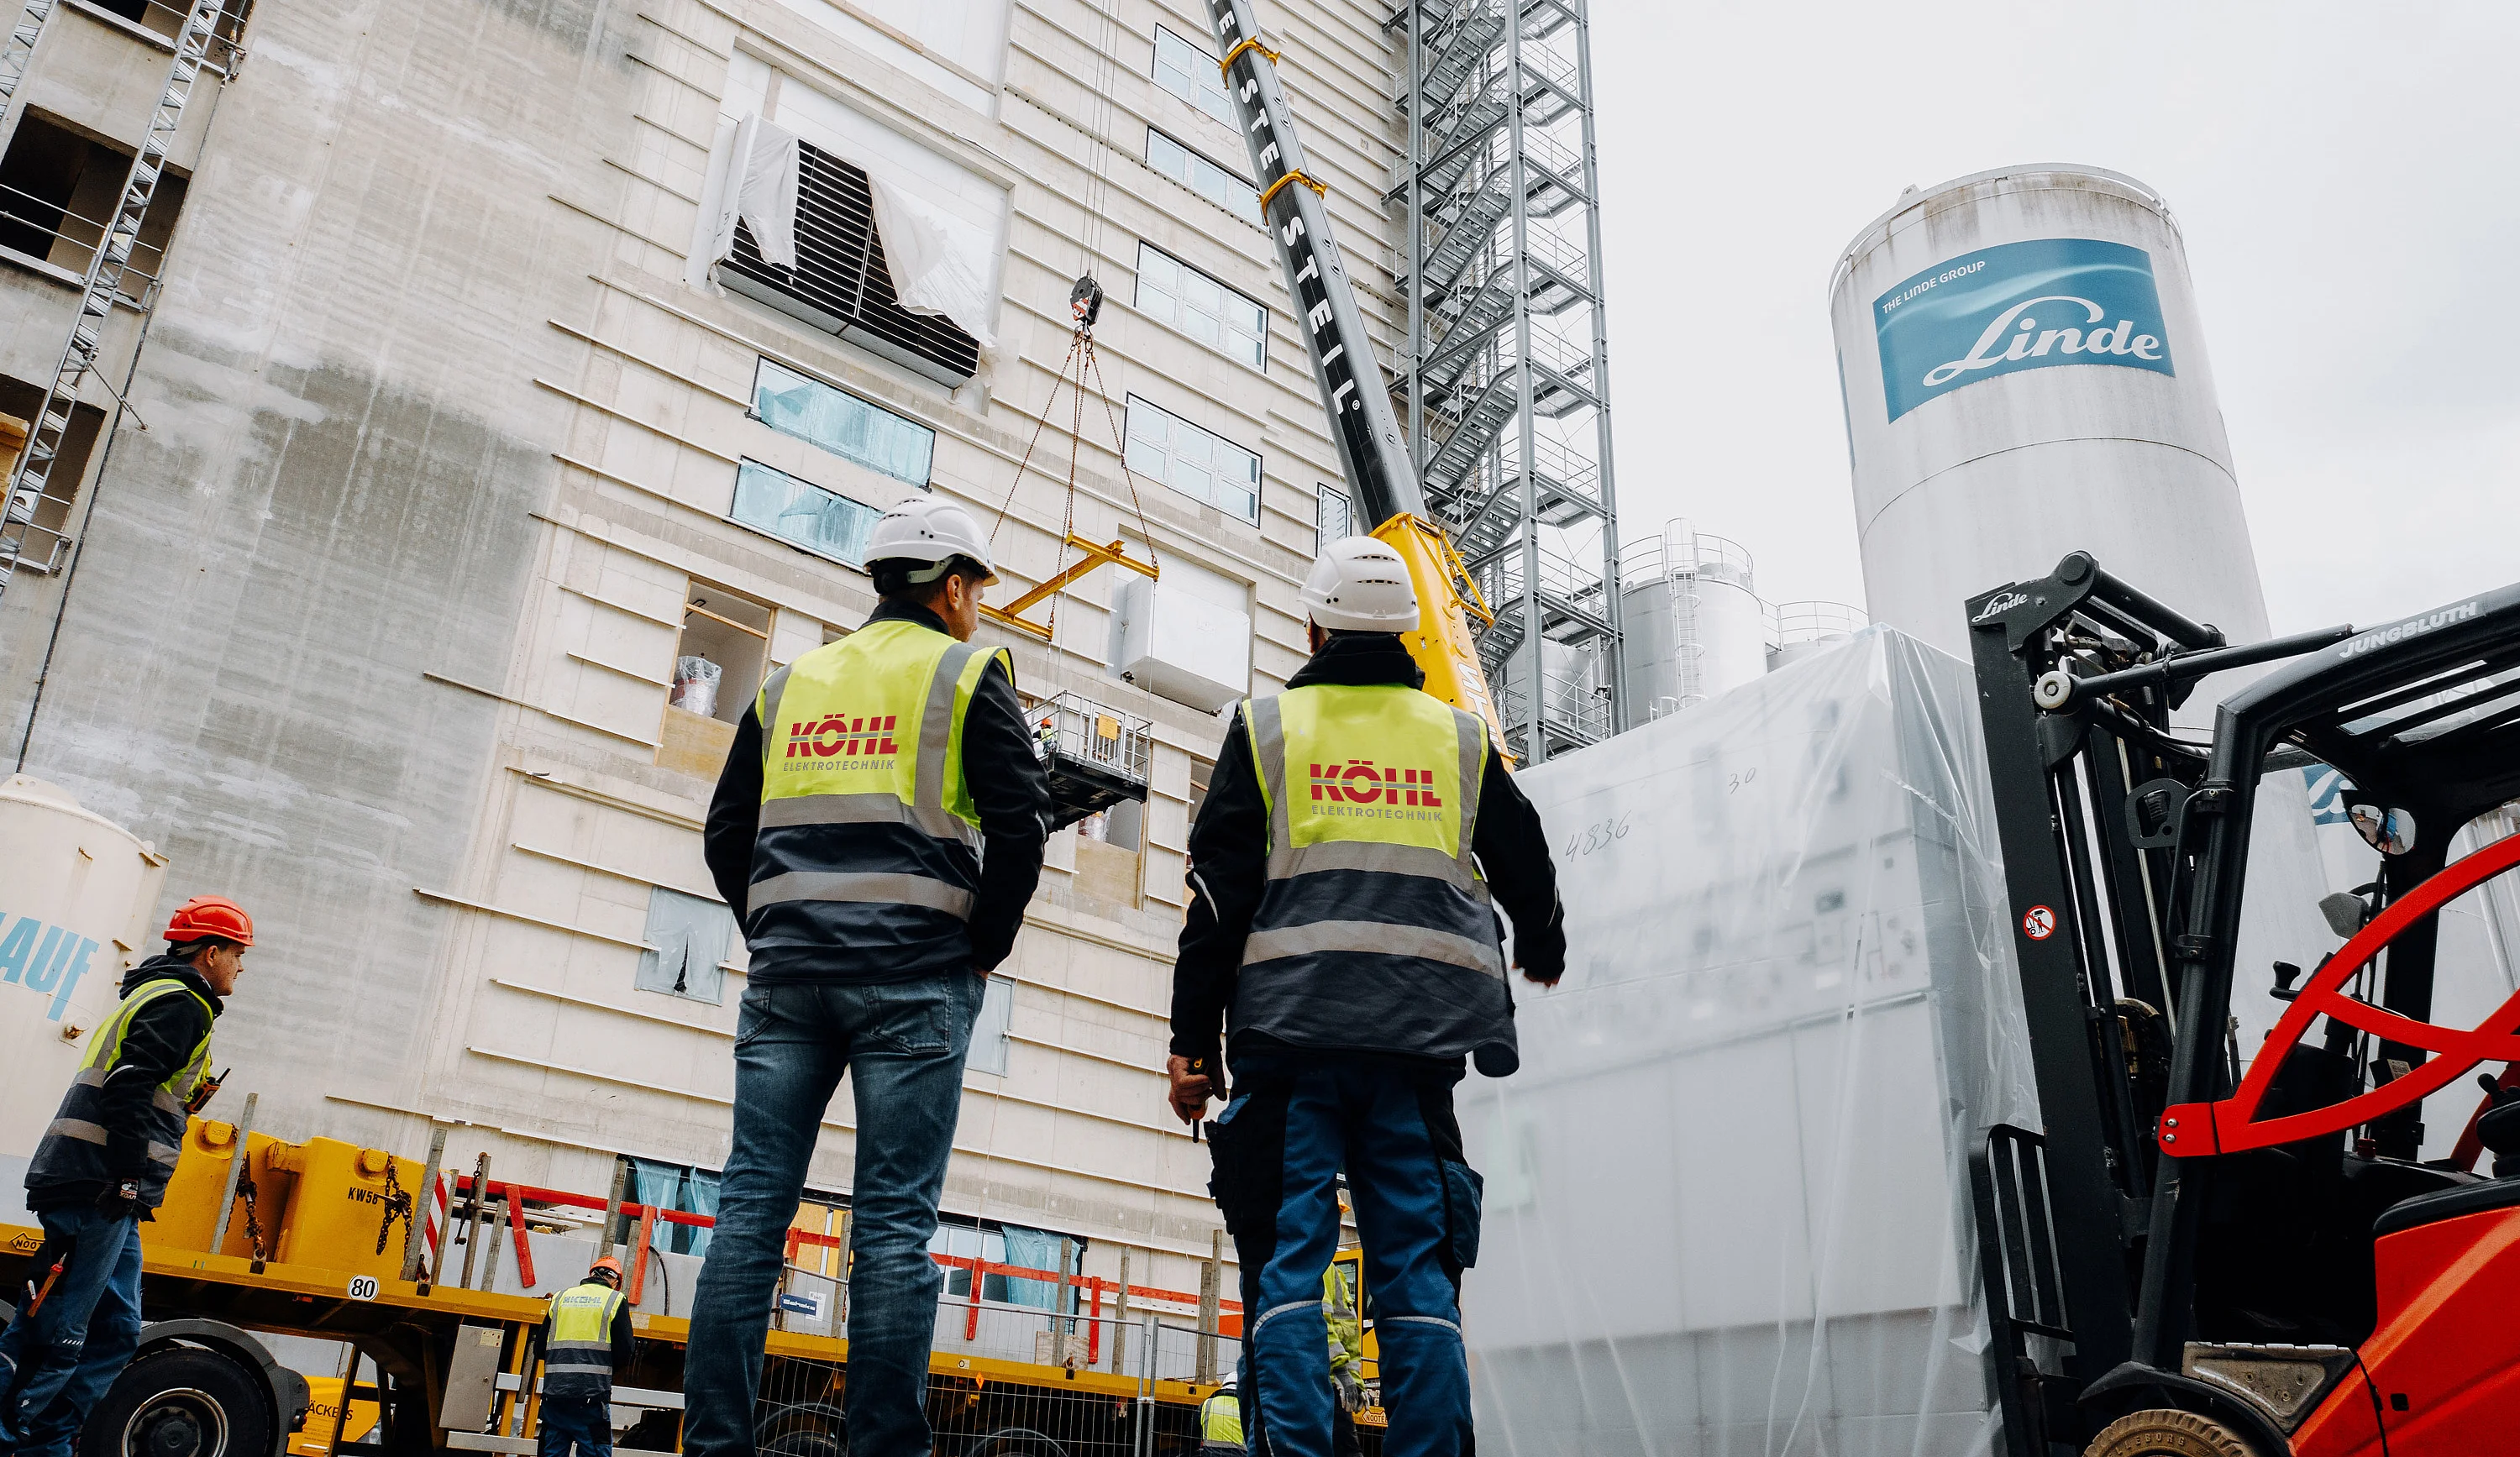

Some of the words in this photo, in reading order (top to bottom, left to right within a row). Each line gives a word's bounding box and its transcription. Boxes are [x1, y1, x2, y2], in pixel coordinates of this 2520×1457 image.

[1882, 296, 1902, 314] THE
[1904, 277, 1937, 301] LINDE
[1939, 260, 1986, 283] GROUP
[1923, 296, 2162, 386] Linde
[1971, 593, 2028, 622] Linde
[2339, 602, 2477, 658] JUNGBLUTH
[786, 714, 899, 757] KÖHL
[784, 760, 895, 771] ELEKTROTECHNIK
[1310, 760, 1442, 807] KÖHL
[1312, 805, 1442, 820] ELEKTROTECHNIK
[1565, 809, 1632, 862] 4836
[0, 911, 100, 1022] AUF
[351, 1279, 375, 1298] 80
